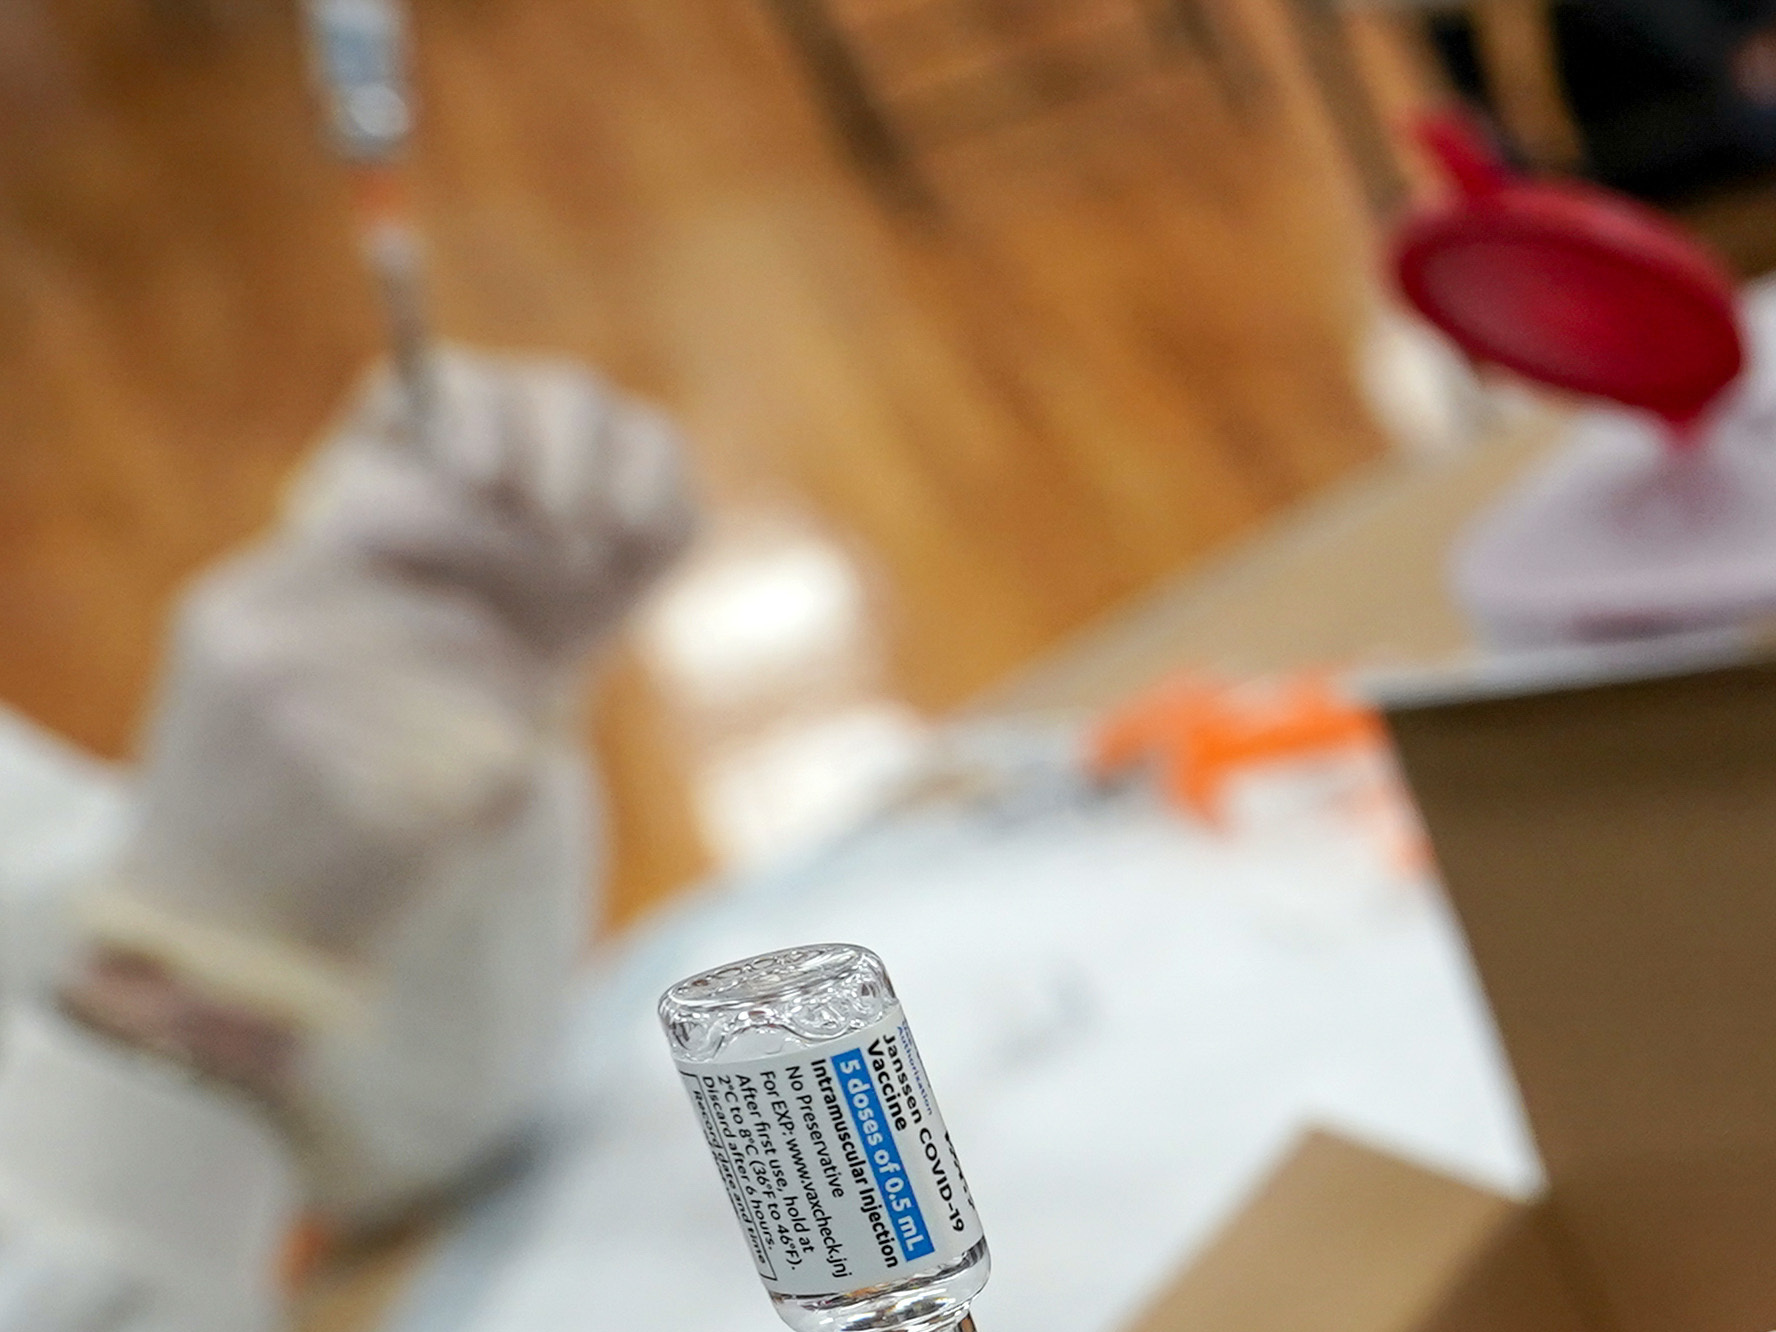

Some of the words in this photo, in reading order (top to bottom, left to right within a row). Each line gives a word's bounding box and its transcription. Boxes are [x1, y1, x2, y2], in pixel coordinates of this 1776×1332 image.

[838, 1058, 861, 1075] 5
[866, 1037, 909, 1132] Vaccine
[701, 1075, 737, 1138] Discard
[784, 1064, 804, 1092] No
[795, 1093, 845, 1198] Preservative
[846, 1077, 884, 1147] doses
[881, 1034, 922, 1124] Janssen
[918, 1126, 965, 1232] COVID-19
[692, 1089, 724, 1149] Record
[713, 1151, 736, 1189] date
[732, 1192, 753, 1224] and
[746, 1226, 766, 1264] time
[727, 1141, 750, 1182] after
[729, 1105, 744, 1125] to
[766, 1201, 781, 1221] to
[734, 1073, 762, 1117] After
[753, 1120, 777, 1155] first
[767, 1158, 788, 1192] use,
[781, 1194, 811, 1233] hold
[797, 1236, 815, 1253] at
[744, 1184, 757, 1196] 6
[758, 1069, 780, 1097] For
[770, 1099, 795, 1136] EXP:
[784, 1137, 853, 1278] www.vaxcheck.jnj
[809, 1057, 869, 1185] Intramuscular
[858, 1186, 899, 1268] Injection
[872, 1148, 901, 1173] of
[883, 1176, 912, 1212] 0.5
[749, 1198, 775, 1250] hours.
[896, 1214, 925, 1252] mL
